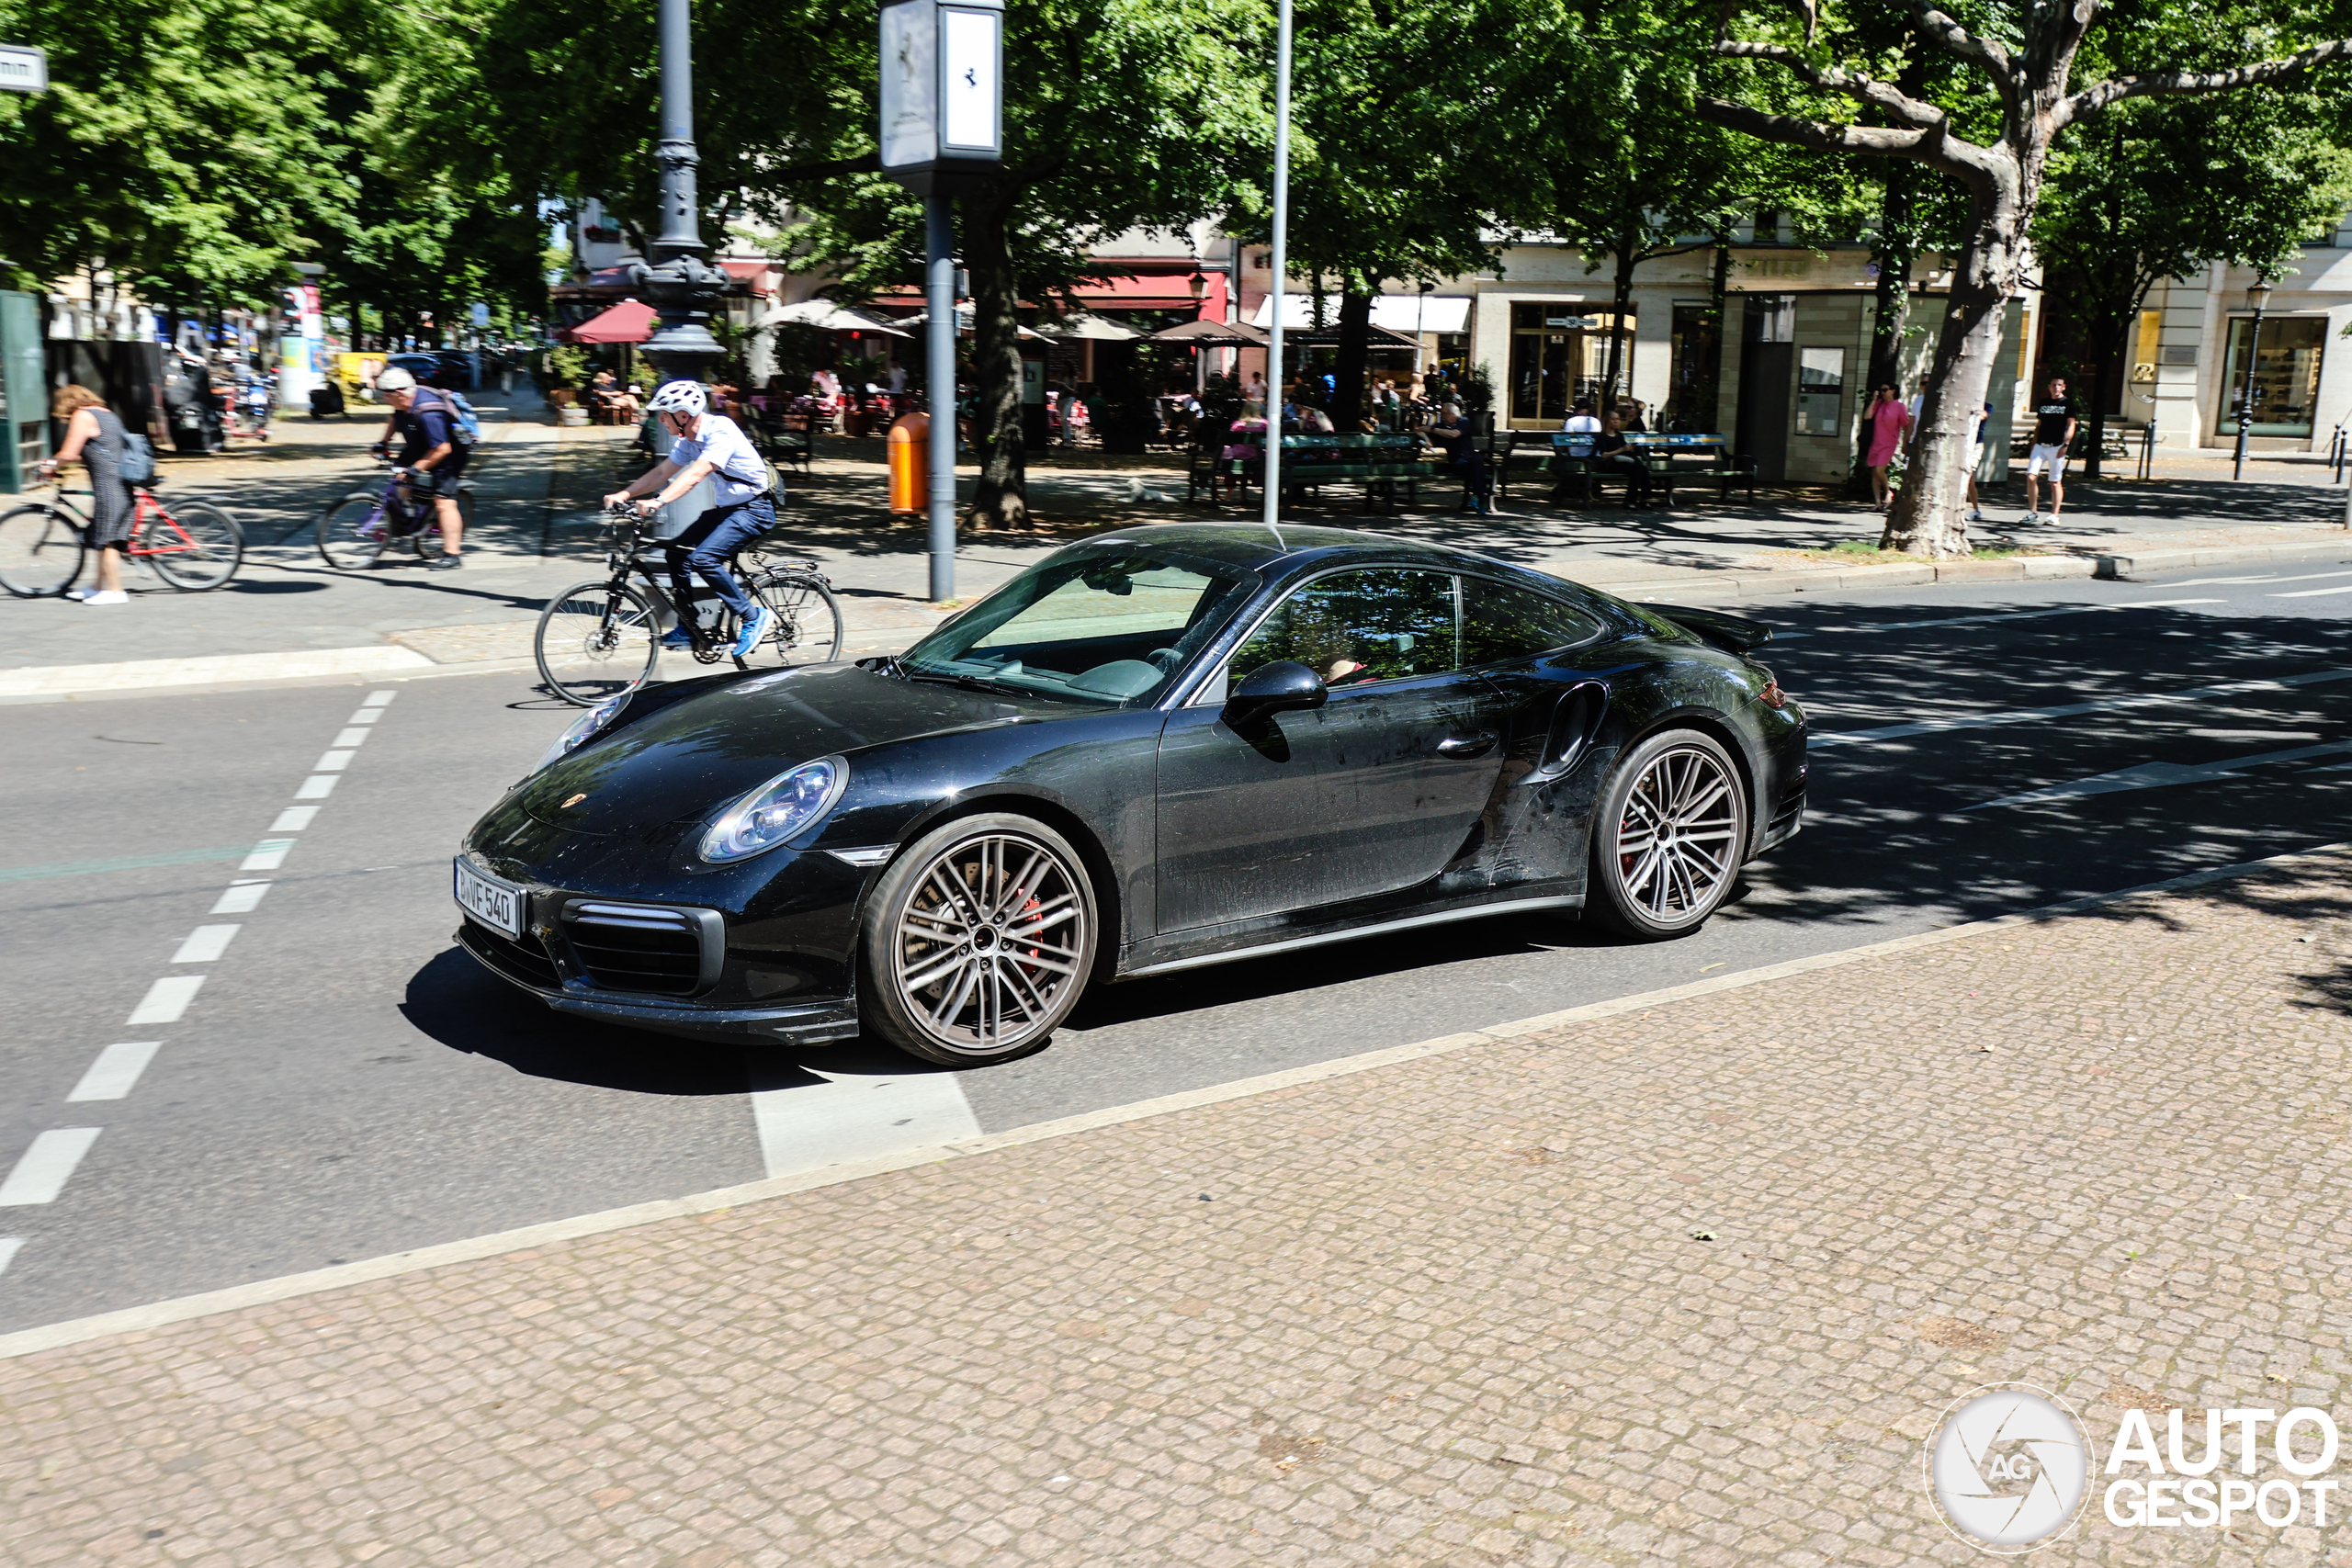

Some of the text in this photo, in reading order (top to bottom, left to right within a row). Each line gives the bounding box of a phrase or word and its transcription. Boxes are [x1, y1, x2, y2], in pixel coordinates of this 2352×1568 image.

[459, 870, 466, 900] B
[469, 877, 483, 911] VF
[485, 886, 510, 926] 540
